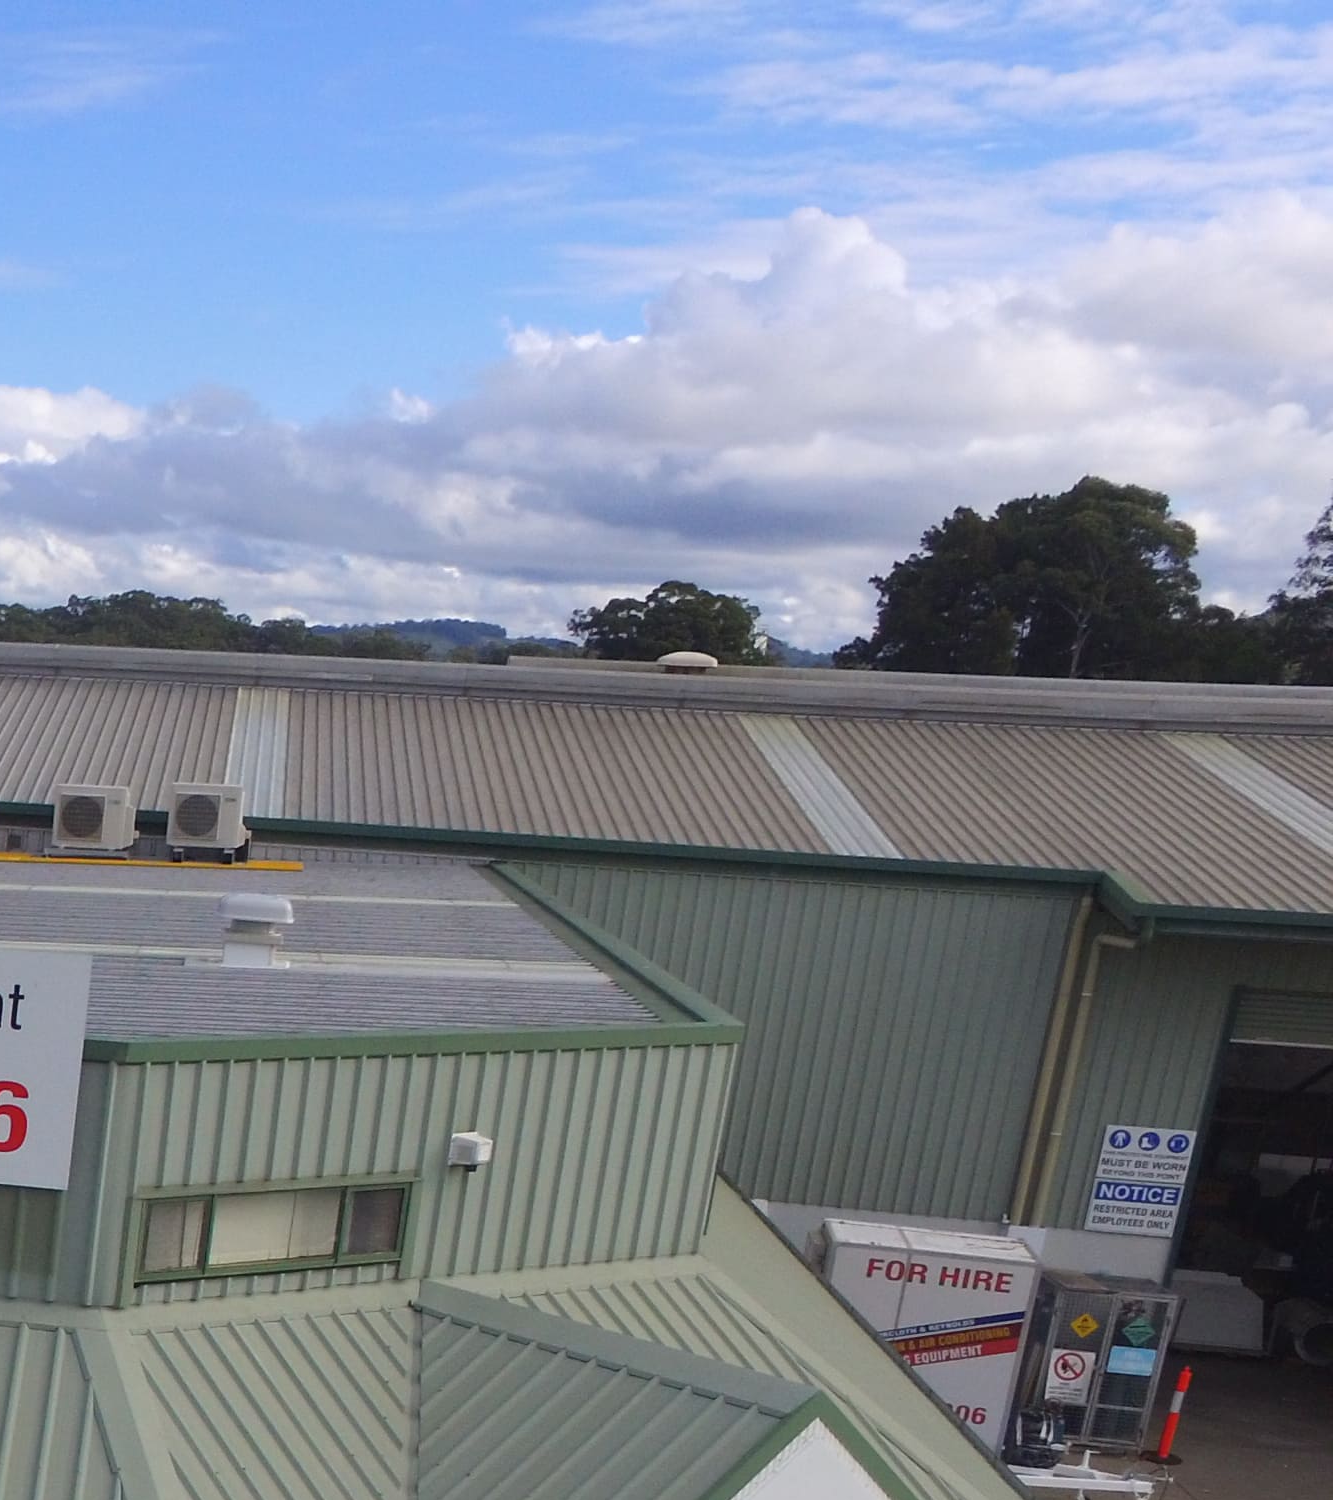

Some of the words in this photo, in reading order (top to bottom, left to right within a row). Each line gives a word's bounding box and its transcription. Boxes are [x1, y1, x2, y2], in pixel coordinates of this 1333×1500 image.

[1101, 1158, 1132, 1167] MUST
[1134, 1160, 1149, 1168] BE
[1152, 1162, 1187, 1172] WORN
[1102, 1168, 1134, 1177] BEYOND
[1099, 1183, 1177, 1204] NOTICE
[1093, 1204, 1148, 1217] RESTRICTED
[1150, 1209, 1173, 1218] AREA
[1092, 1216, 1144, 1227] EMPLOYEES
[1146, 1220, 1170, 1230] ONLY
[866, 1258, 928, 1284] FOR
[938, 1266, 1014, 1293] HIRE
[919, 1339, 937, 1349] AIR
[939, 1327, 1011, 1346] CONDITIONING
[914, 1344, 983, 1365] EQUIPMENT
